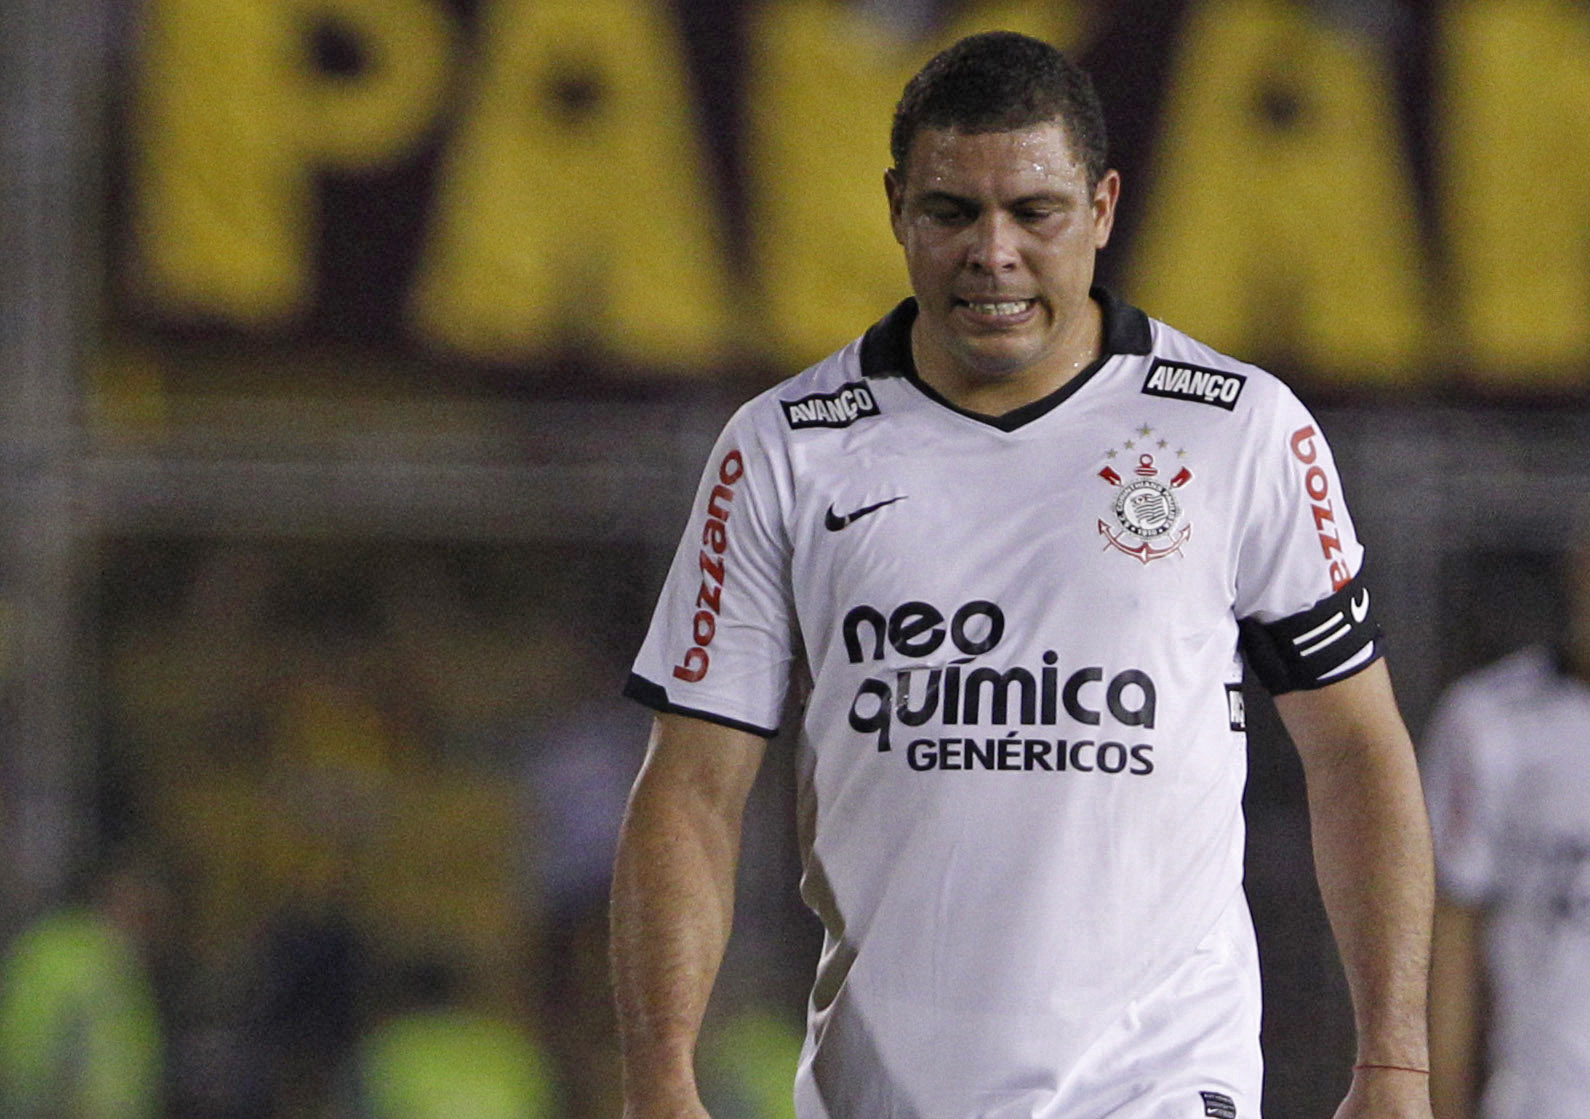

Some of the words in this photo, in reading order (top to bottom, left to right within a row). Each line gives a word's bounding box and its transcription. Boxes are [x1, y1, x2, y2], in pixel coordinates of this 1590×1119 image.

[789, 388, 874, 423] AVANÇO
[1146, 365, 1241, 403] AVANÇO
[1290, 424, 1352, 592] bozza
[672, 449, 744, 683] bozzano
[842, 599, 1005, 664] neo
[848, 649, 1157, 753] química
[906, 730, 1155, 776] GENÉRICOS
